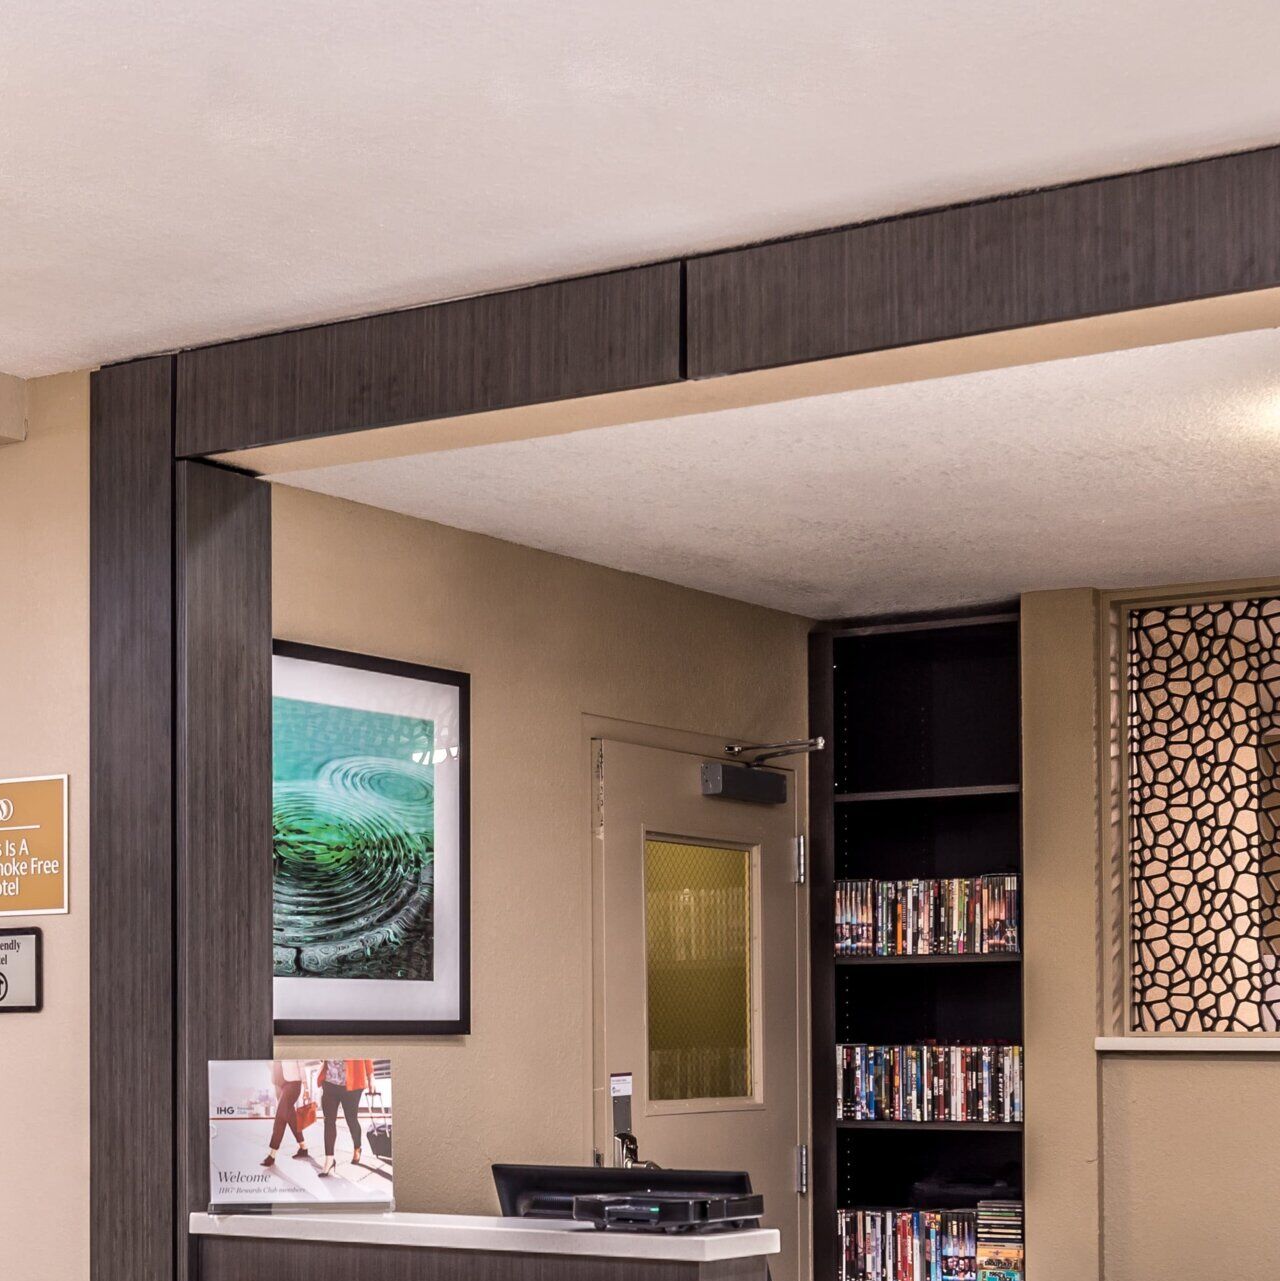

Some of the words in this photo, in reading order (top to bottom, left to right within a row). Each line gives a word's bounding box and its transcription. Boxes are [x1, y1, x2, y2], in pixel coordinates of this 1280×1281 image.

[5, 839, 16, 856] Is
[19, 838, 29, 855] A
[30, 857, 60, 875] Free
[216, 1106, 235, 1115] IHG
[218, 1171, 271, 1183] Welcome
